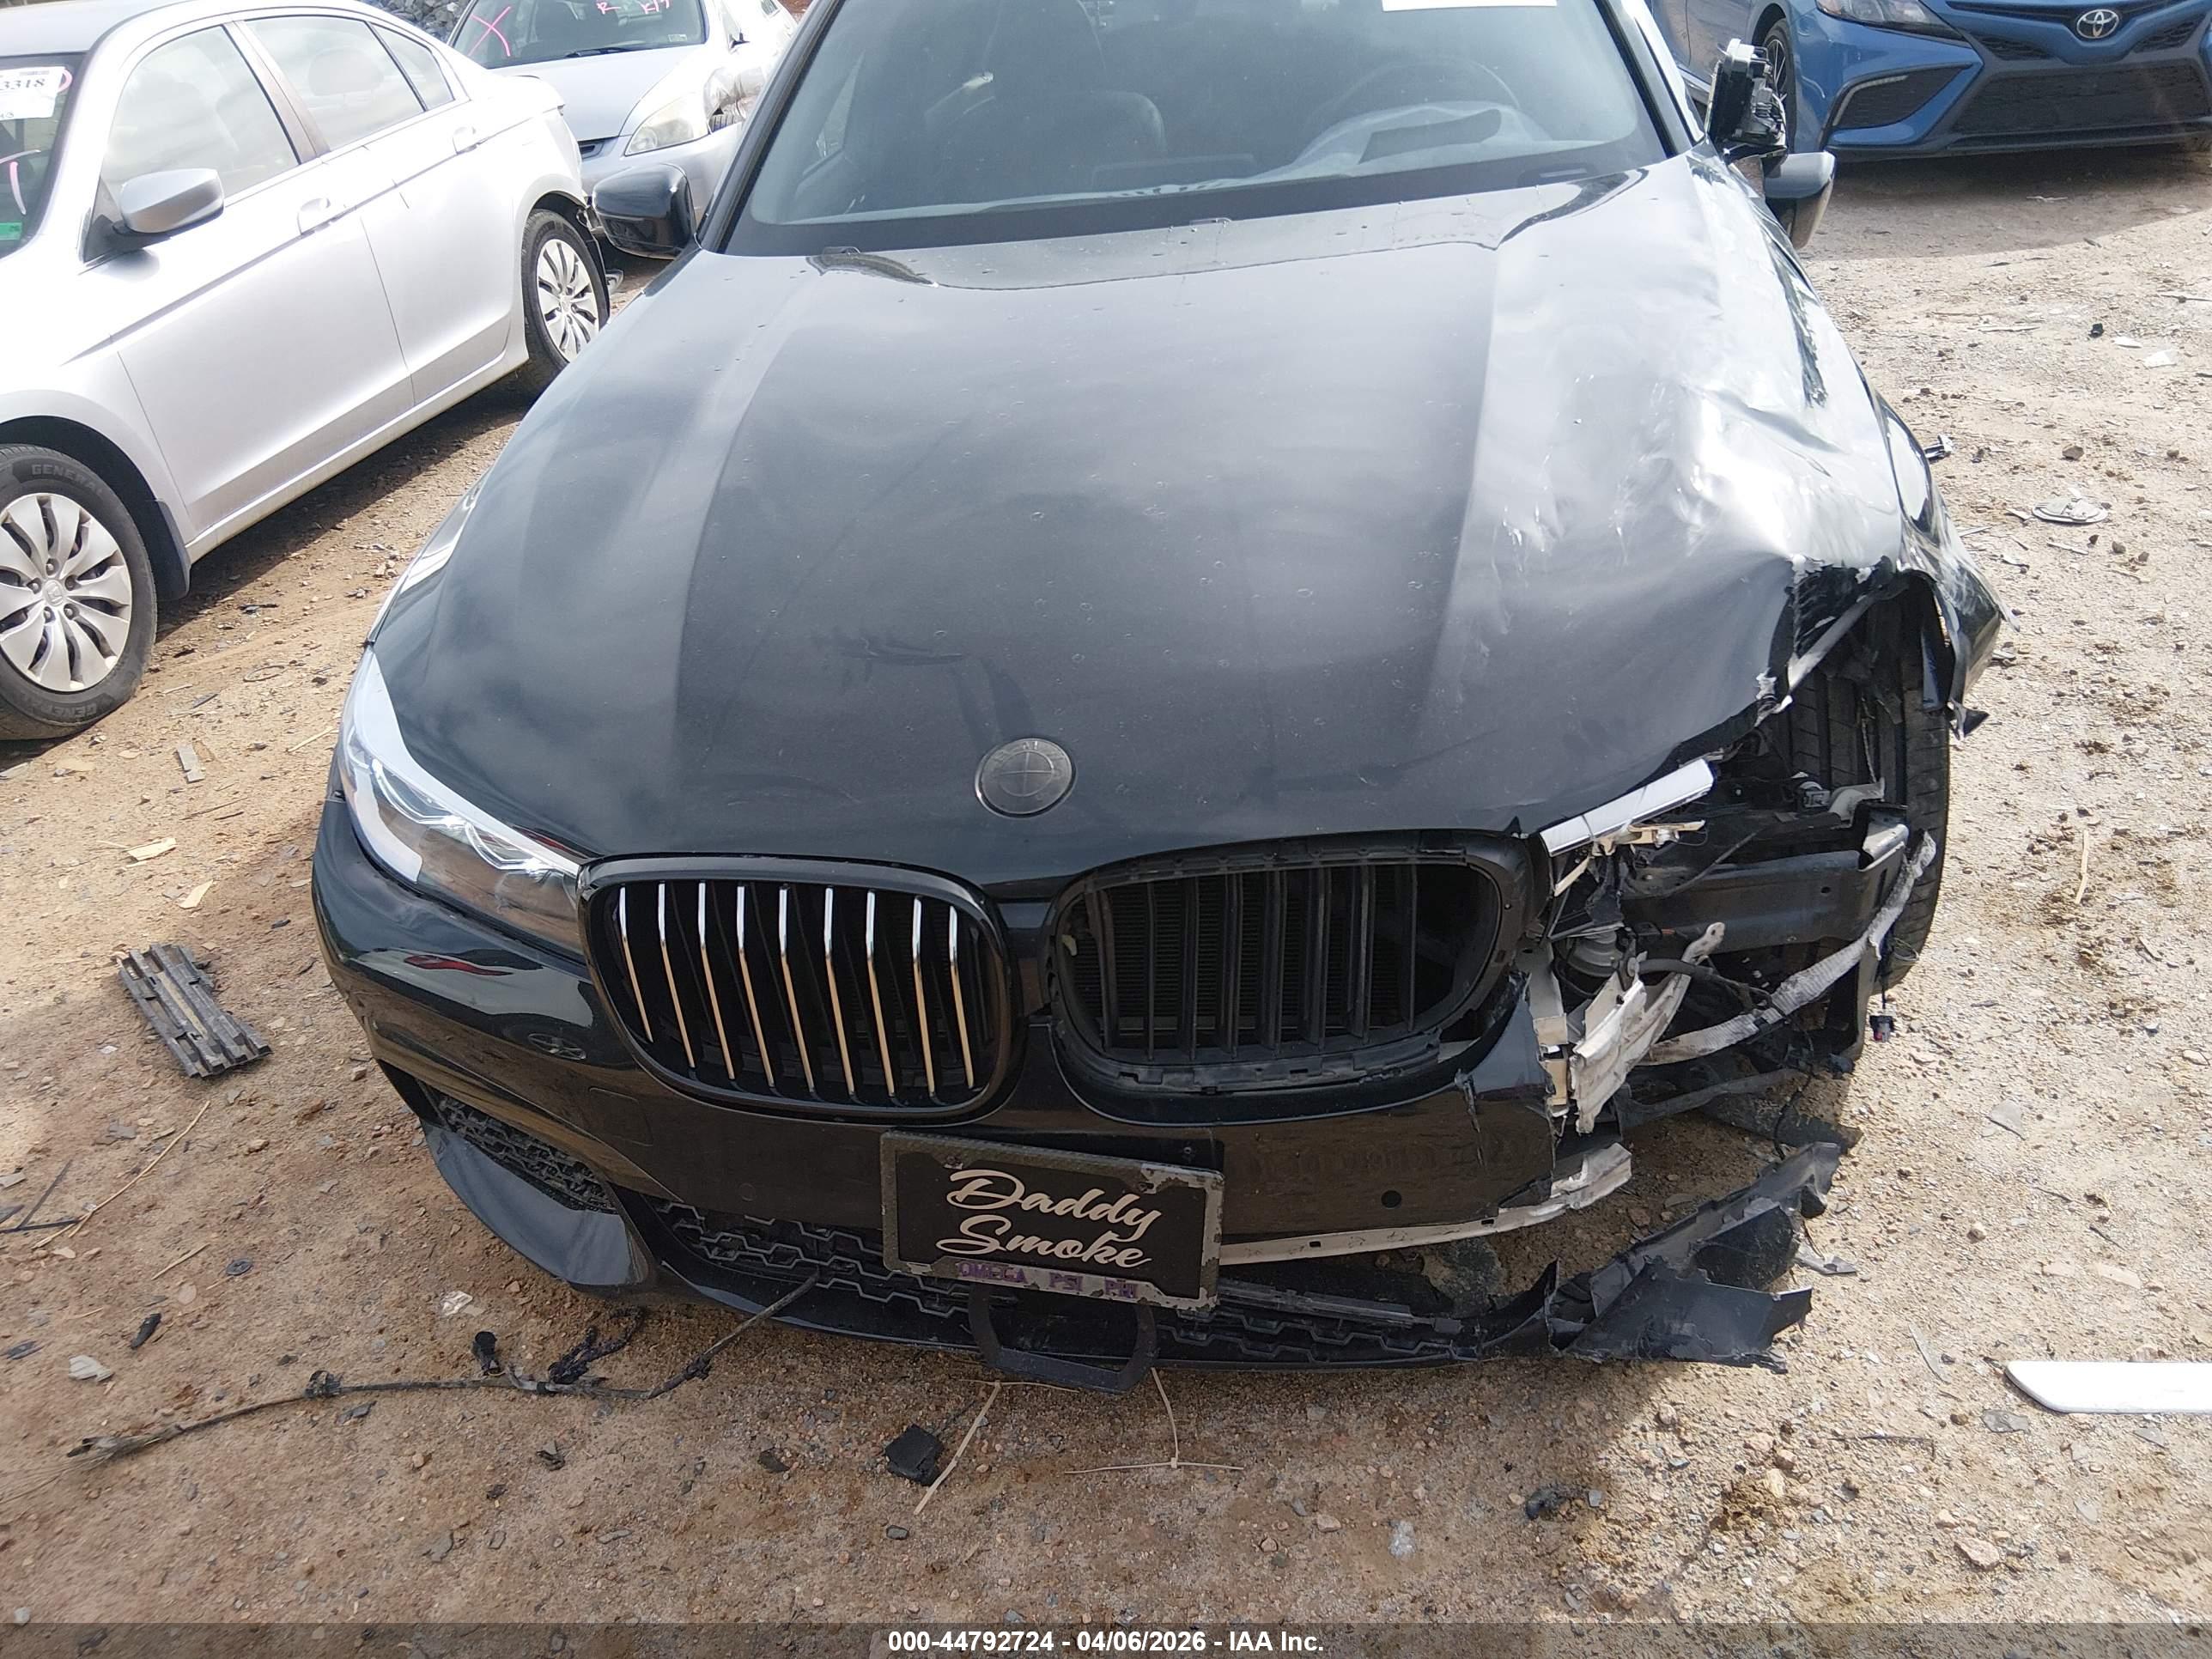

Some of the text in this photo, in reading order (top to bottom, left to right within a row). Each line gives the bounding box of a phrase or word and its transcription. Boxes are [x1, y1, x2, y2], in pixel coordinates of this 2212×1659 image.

[946, 1169, 1162, 1243] Daddy
[935, 1214, 1152, 1267] Smoke
[957, 1261, 1028, 1285] OMEGA
